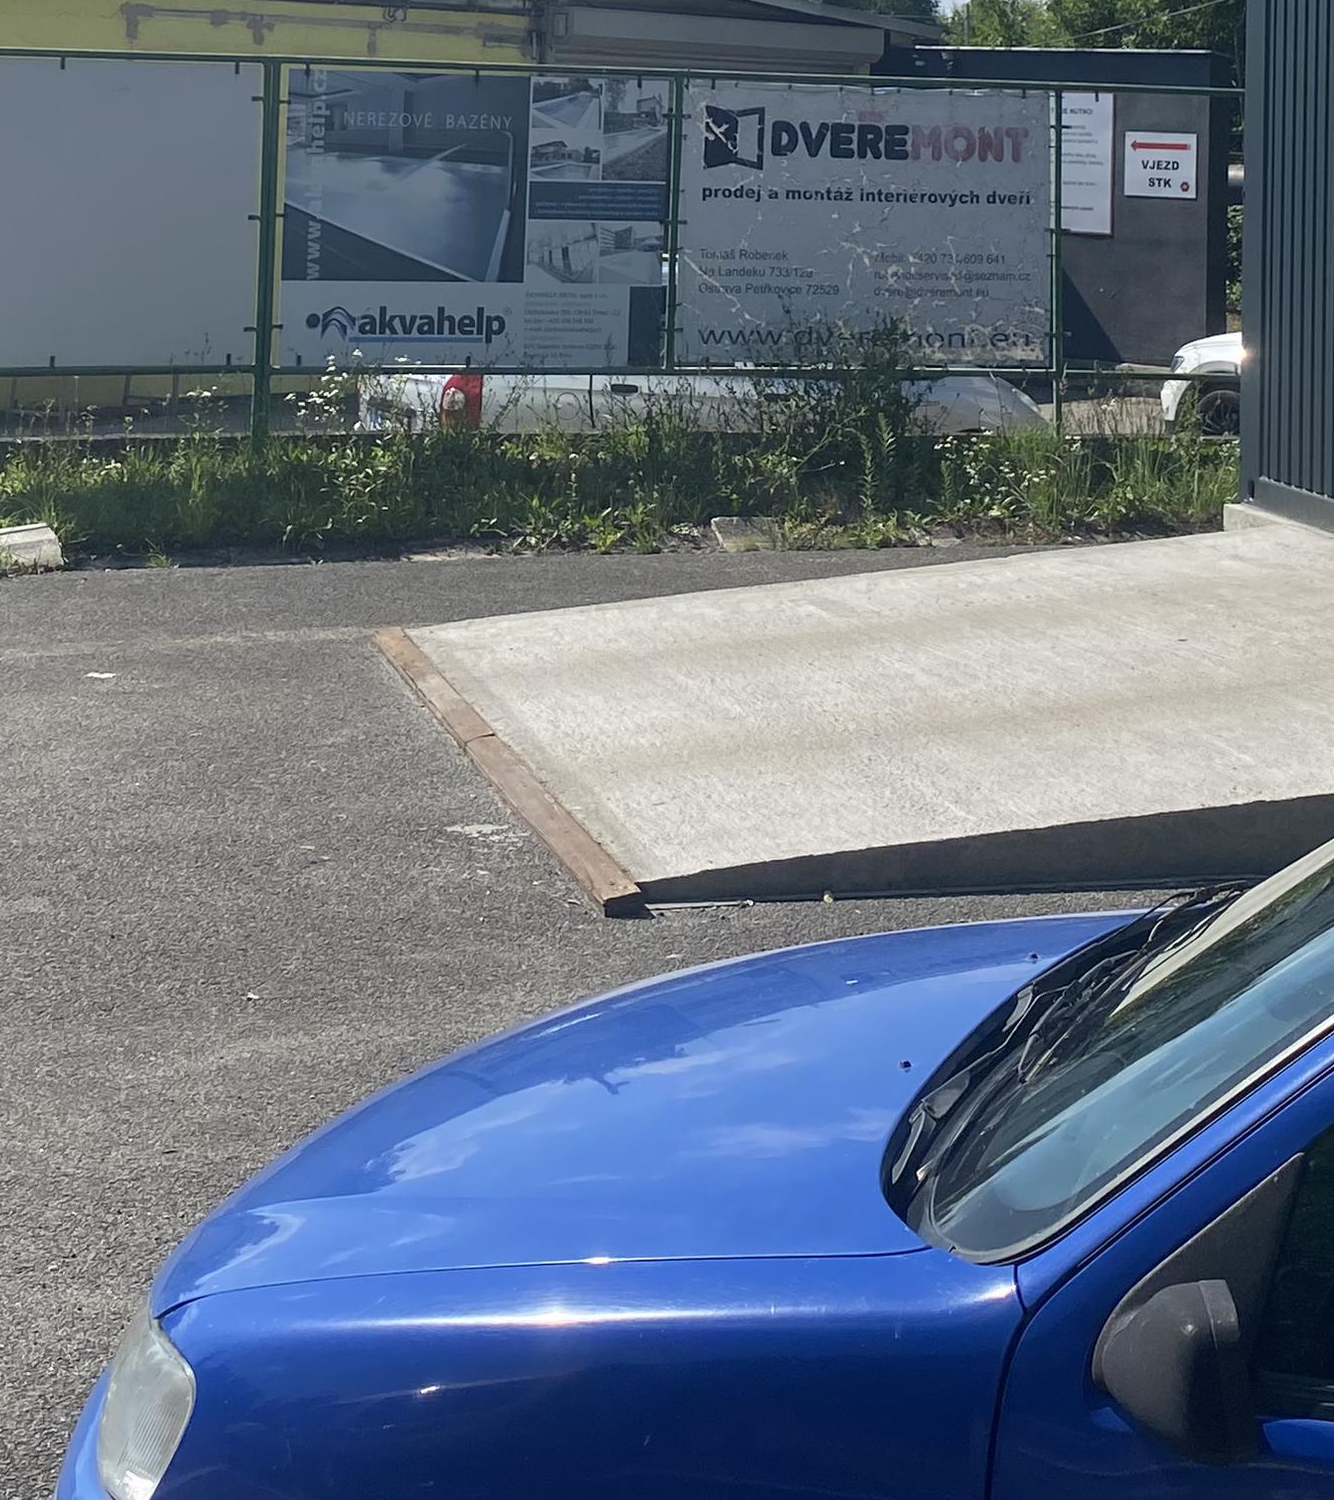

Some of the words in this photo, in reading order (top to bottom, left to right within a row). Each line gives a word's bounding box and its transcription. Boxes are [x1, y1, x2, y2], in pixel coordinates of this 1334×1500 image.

[343, 111, 432, 129] NEREZOVÉ
[445, 113, 514, 130] BAZÉNY
[1141, 159, 1180, 171] VJEZD
[1148, 177, 1172, 189] STK
[701, 184, 761, 202] prodej
[768, 189, 779, 200] a
[785, 186, 854, 202] montáž
[859, 187, 980, 208] interiérových
[986, 190, 1030, 205] dveří
[358, 305, 506, 344] akvahelp
